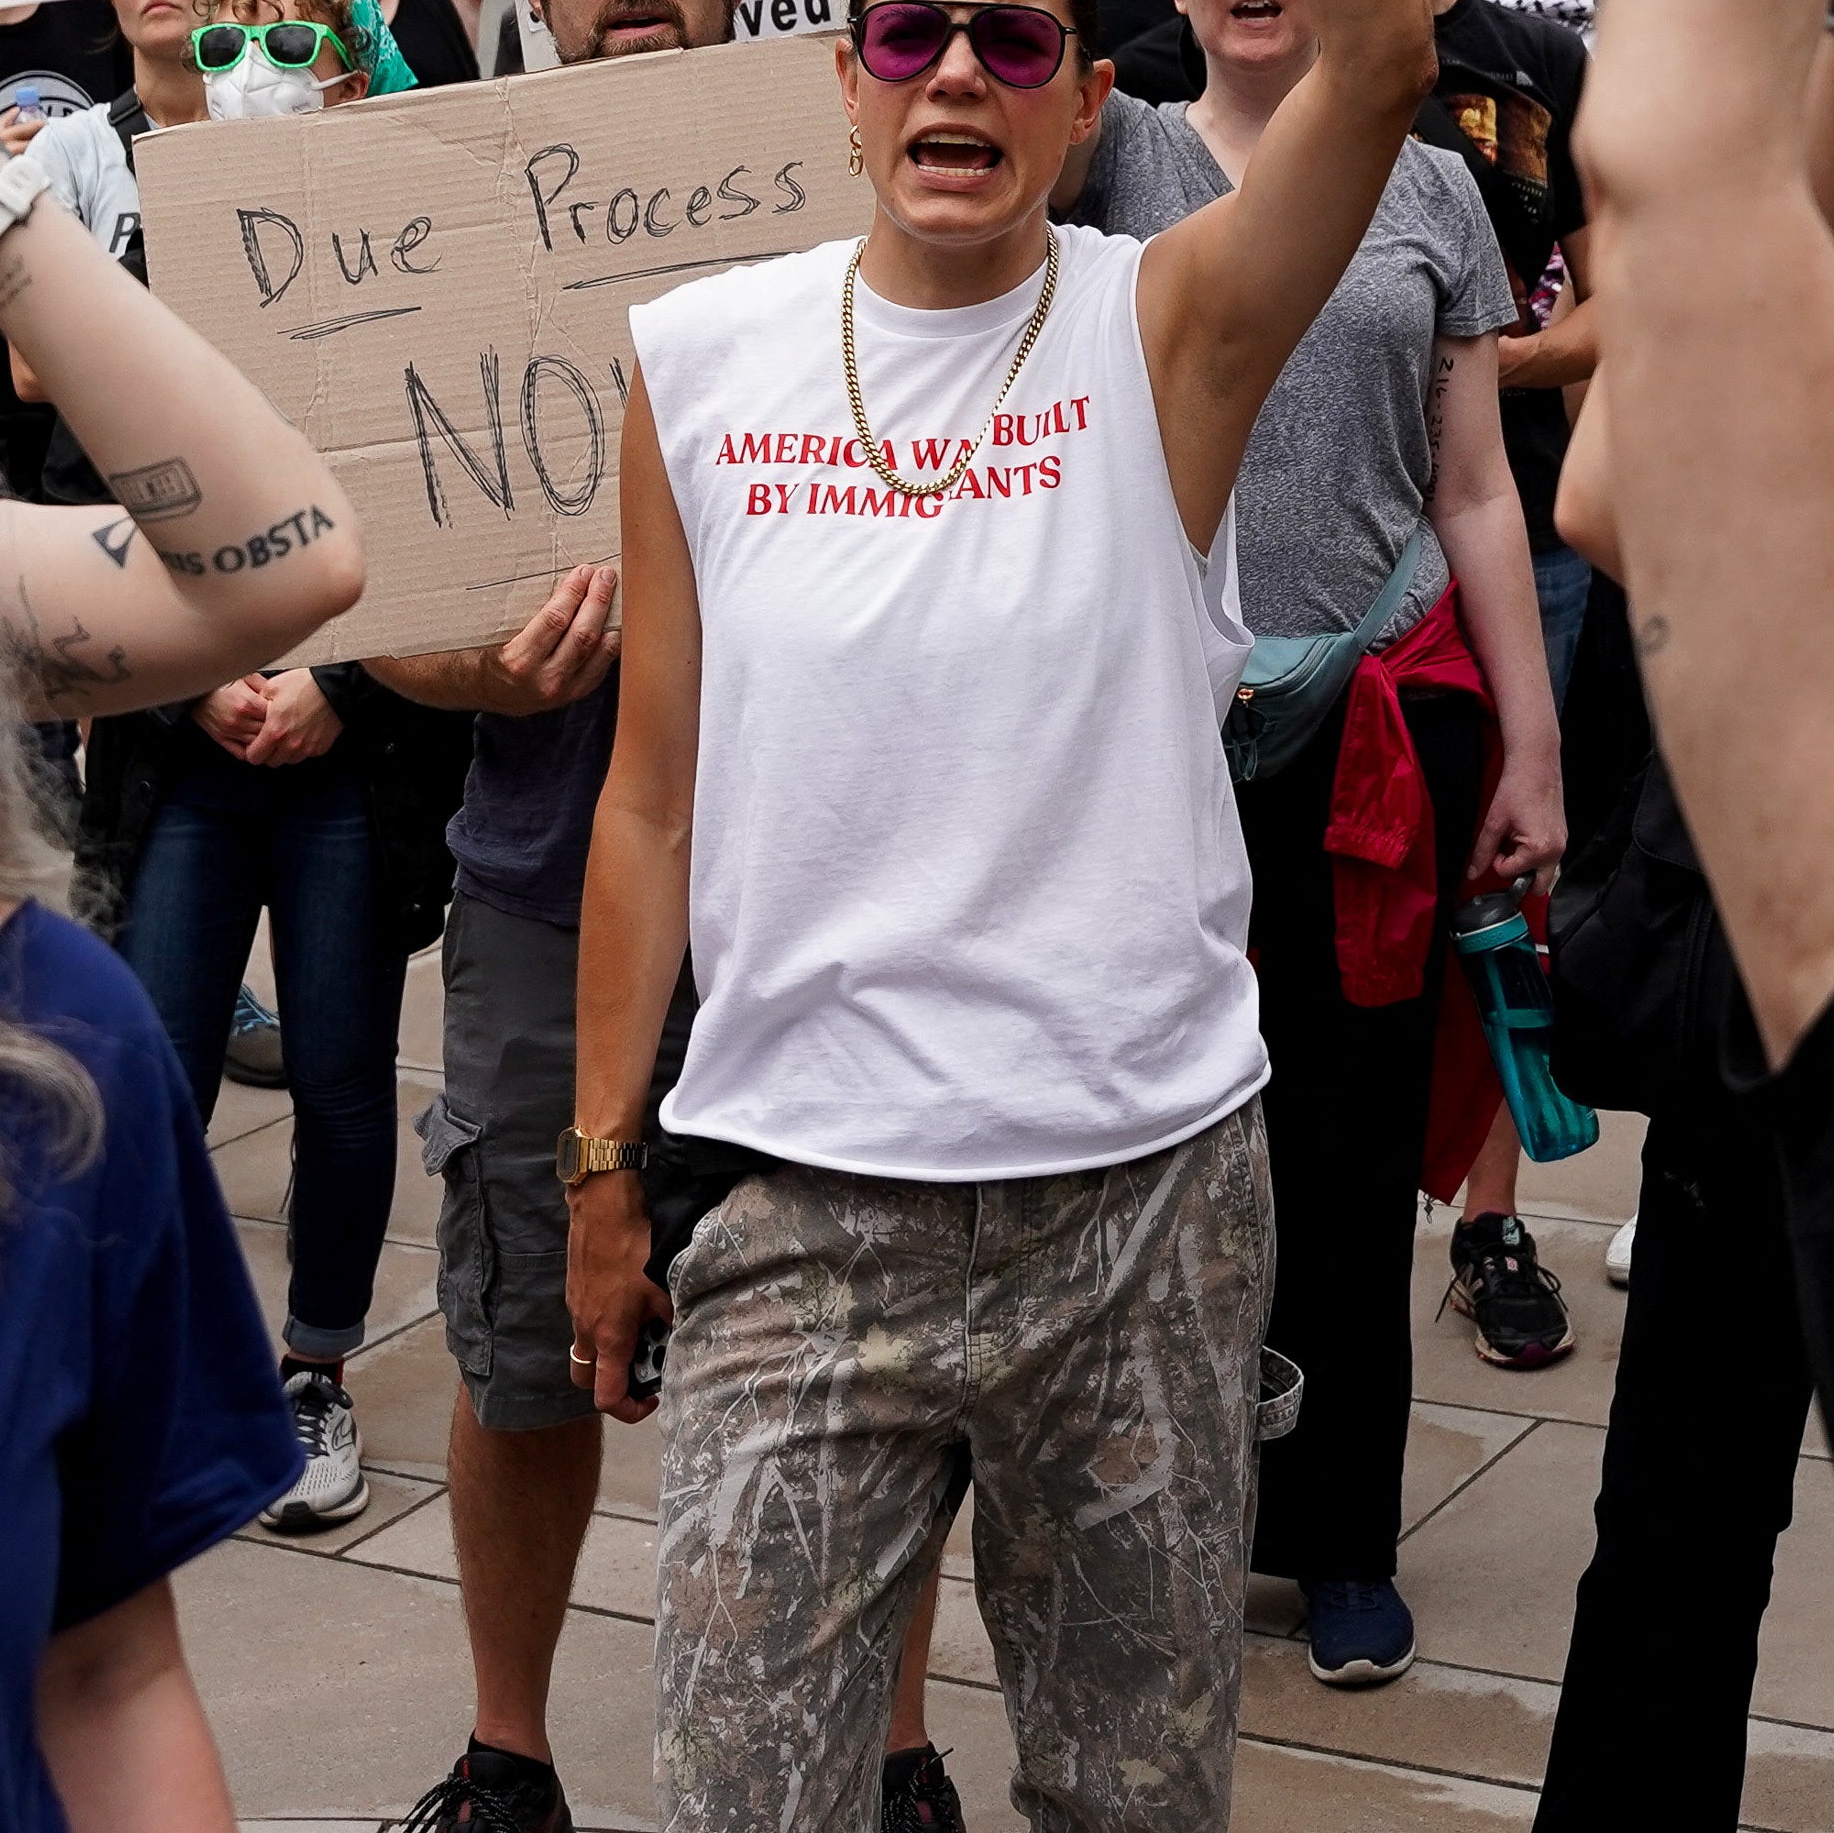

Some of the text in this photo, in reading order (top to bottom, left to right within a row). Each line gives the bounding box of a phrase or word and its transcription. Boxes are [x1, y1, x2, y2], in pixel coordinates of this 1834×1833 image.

[236, 142, 807, 309] Due Process
[714, 432, 898, 472] AMERICA
[992, 396, 1091, 449] BUILT
[745, 454, 1062, 519] BY IMMIGANTS
[212, 504, 336, 574] OBSTA
